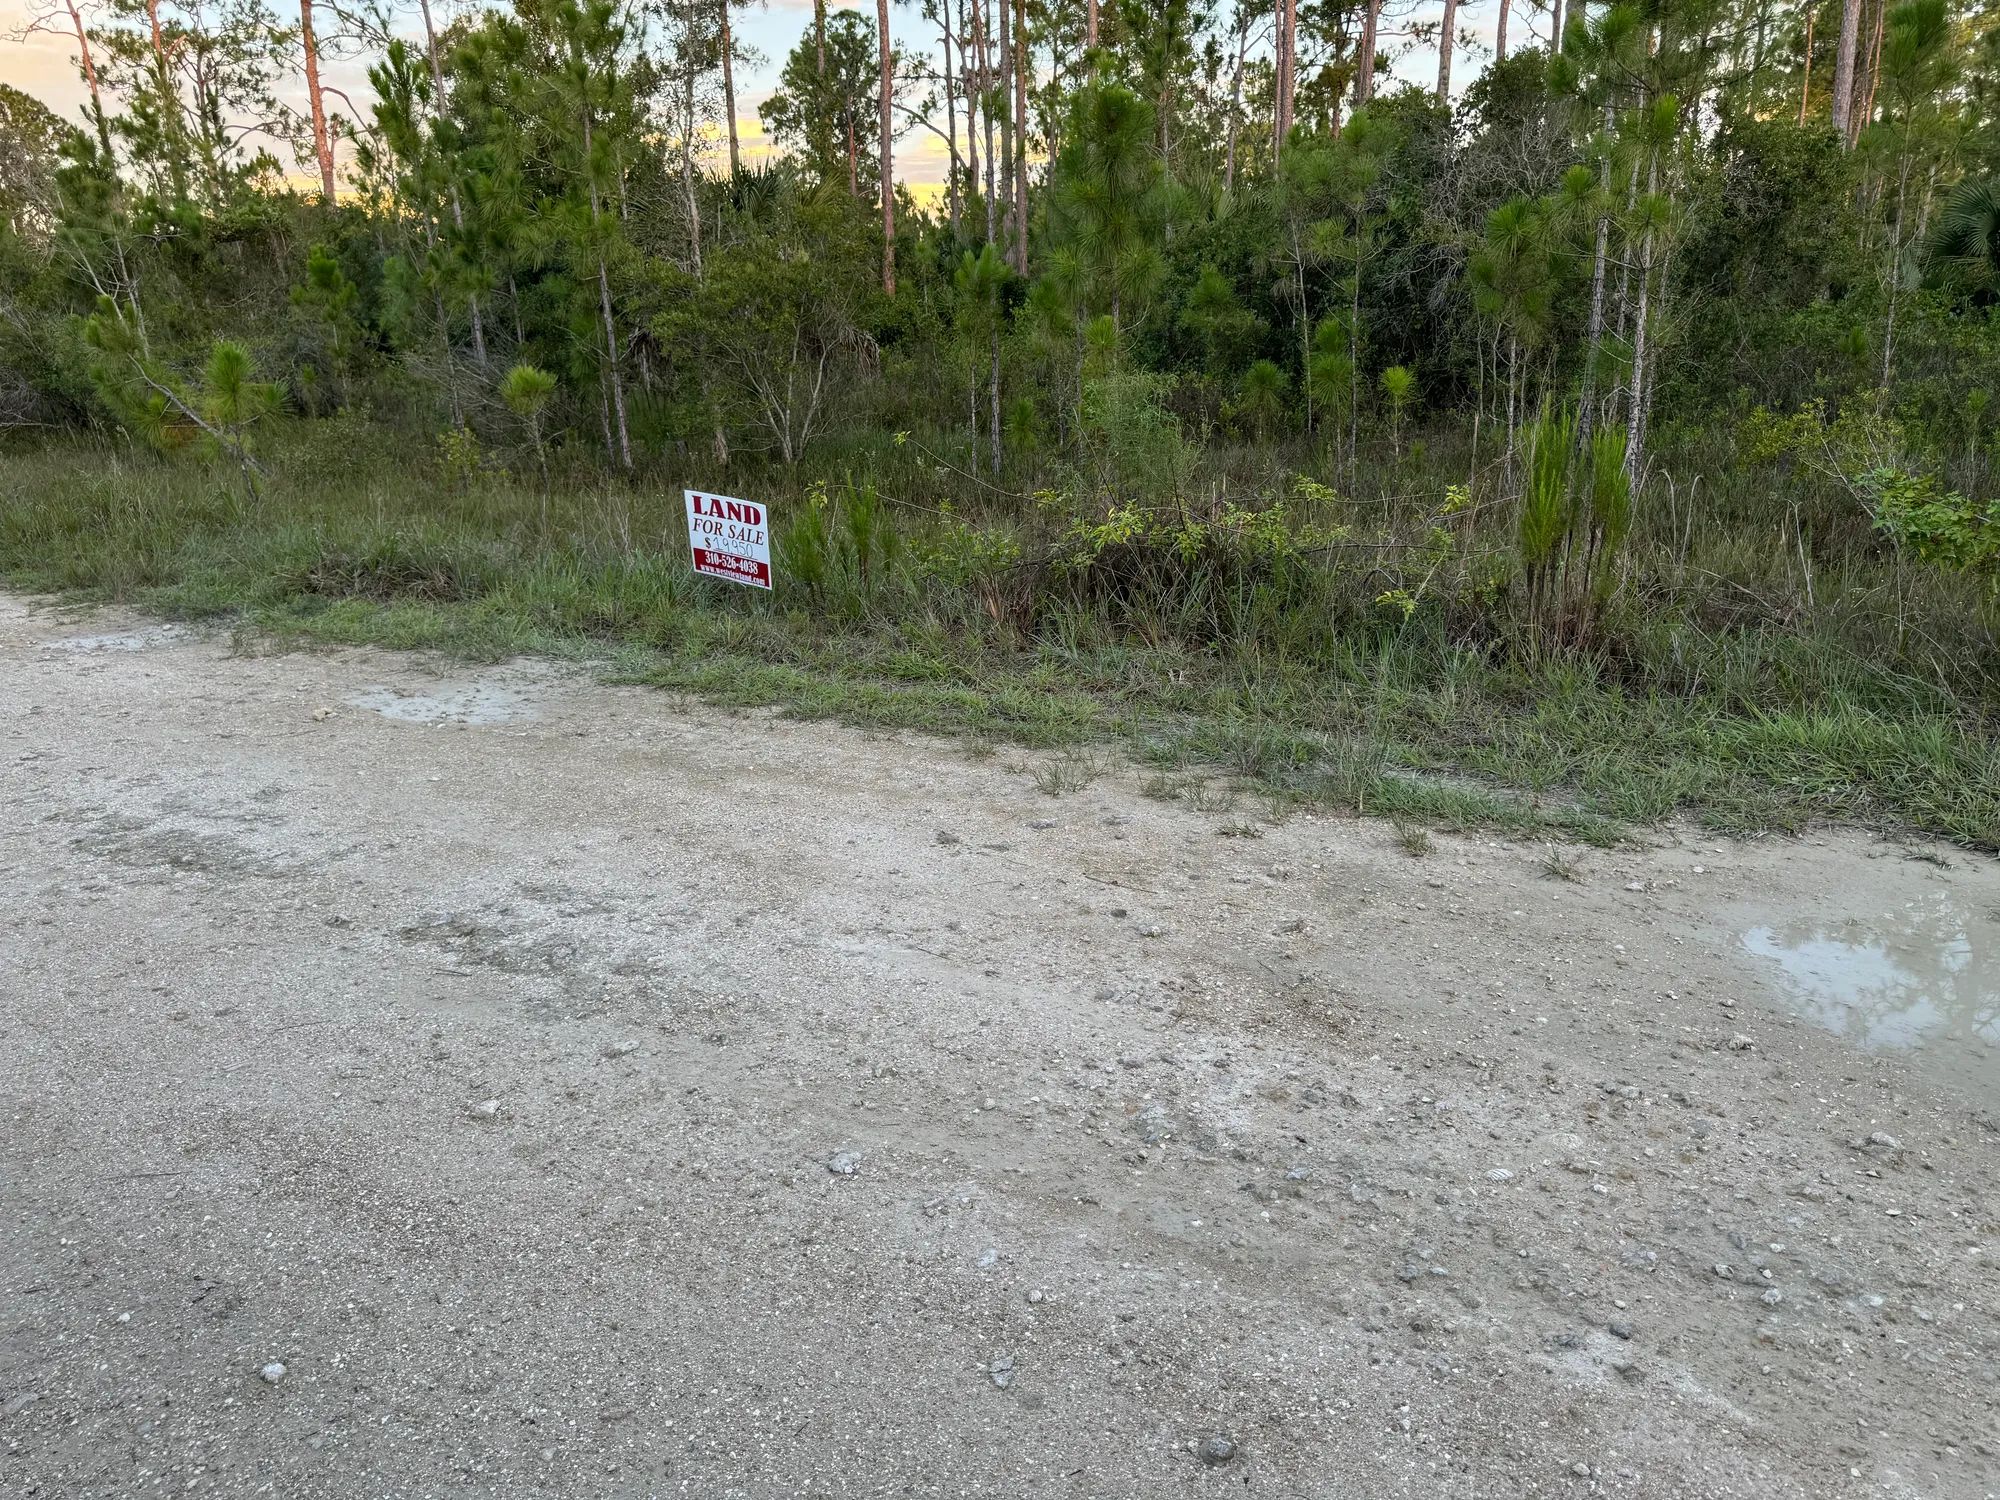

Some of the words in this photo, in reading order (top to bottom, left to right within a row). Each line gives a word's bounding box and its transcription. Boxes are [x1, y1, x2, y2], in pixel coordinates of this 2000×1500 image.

[692, 495, 761, 526] LAND
[693, 518, 723, 537] FOR
[728, 524, 765, 546] SALE
[705, 551, 758, 575] 310-526-4038
